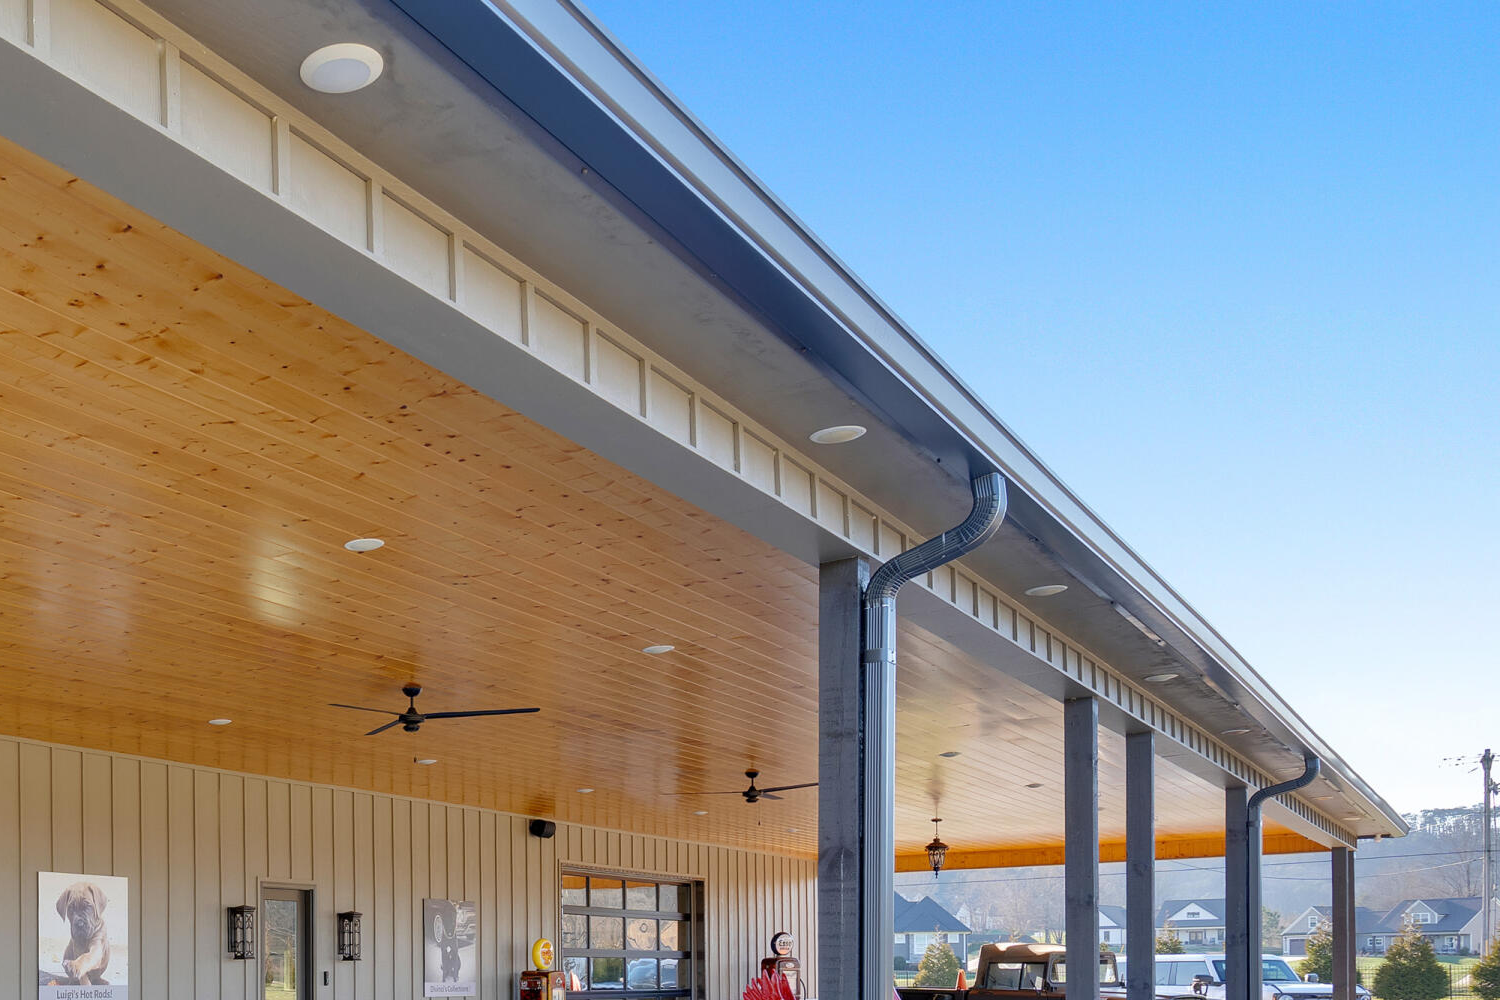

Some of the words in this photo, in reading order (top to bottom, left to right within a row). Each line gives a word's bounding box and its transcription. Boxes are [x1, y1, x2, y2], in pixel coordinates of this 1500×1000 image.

[56, 989, 79, 1000] Luigi's
[80, 989, 93, 999] Hot
[94, 989, 113, 999] Rods!
